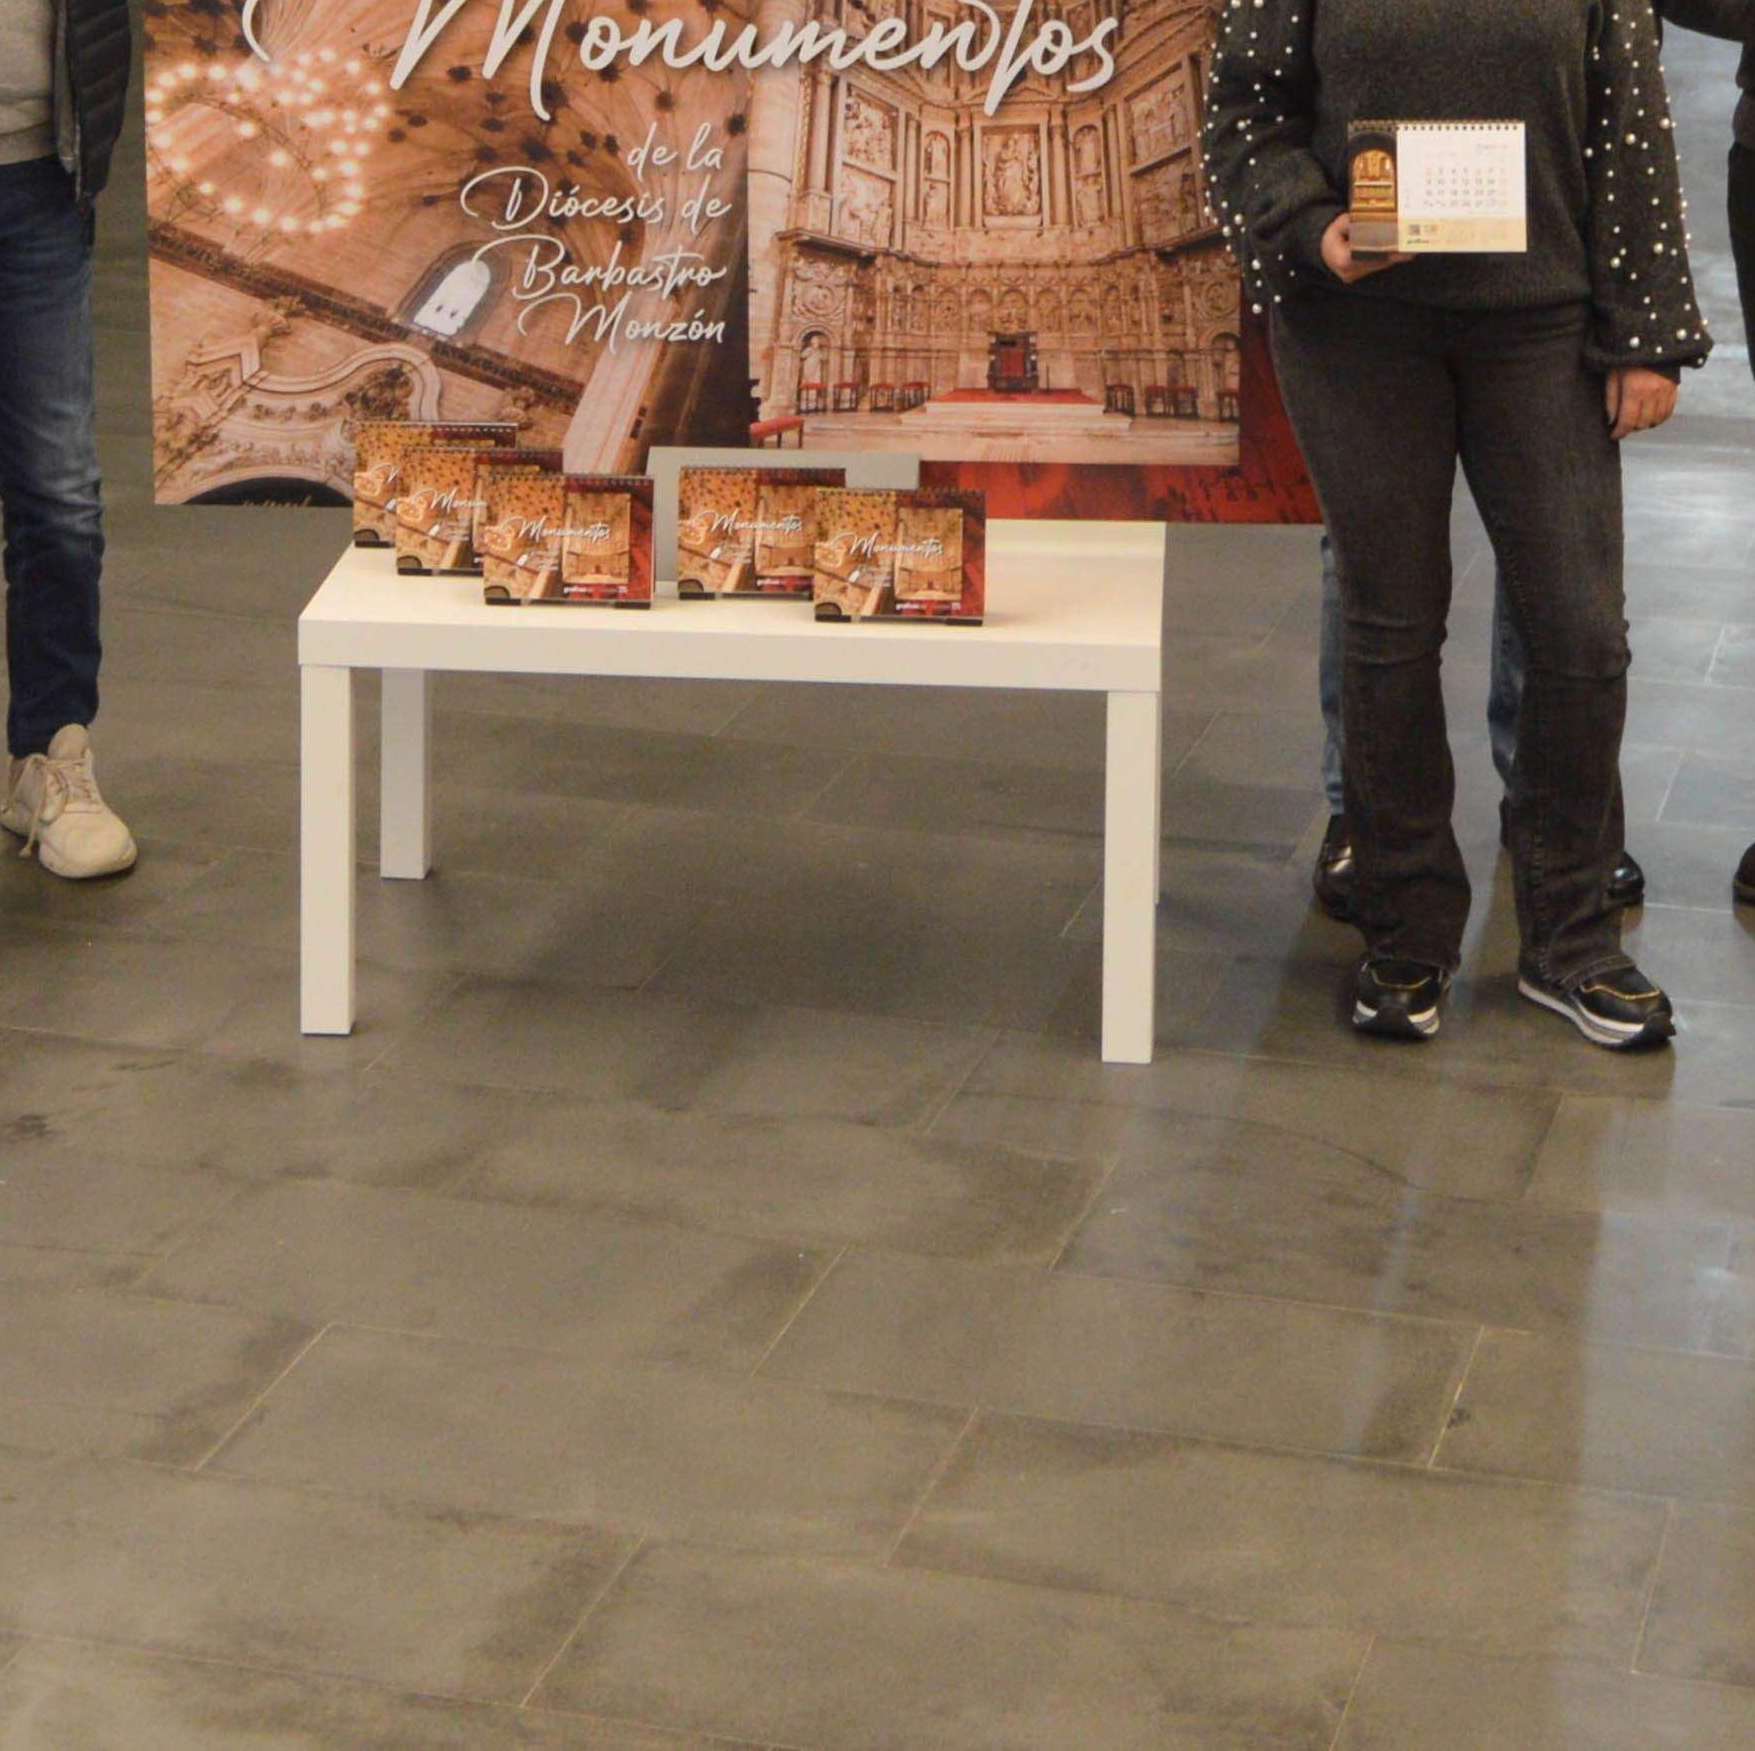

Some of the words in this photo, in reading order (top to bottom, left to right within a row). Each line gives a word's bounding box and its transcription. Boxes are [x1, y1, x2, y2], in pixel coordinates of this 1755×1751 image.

[627, 122, 677, 182] de
[686, 122, 724, 171] la
[460, 166, 664, 230] Diócesis
[682, 174, 732, 235] de
[471, 234, 727, 300] Barbastro
[518, 291, 725, 355] Monzón
